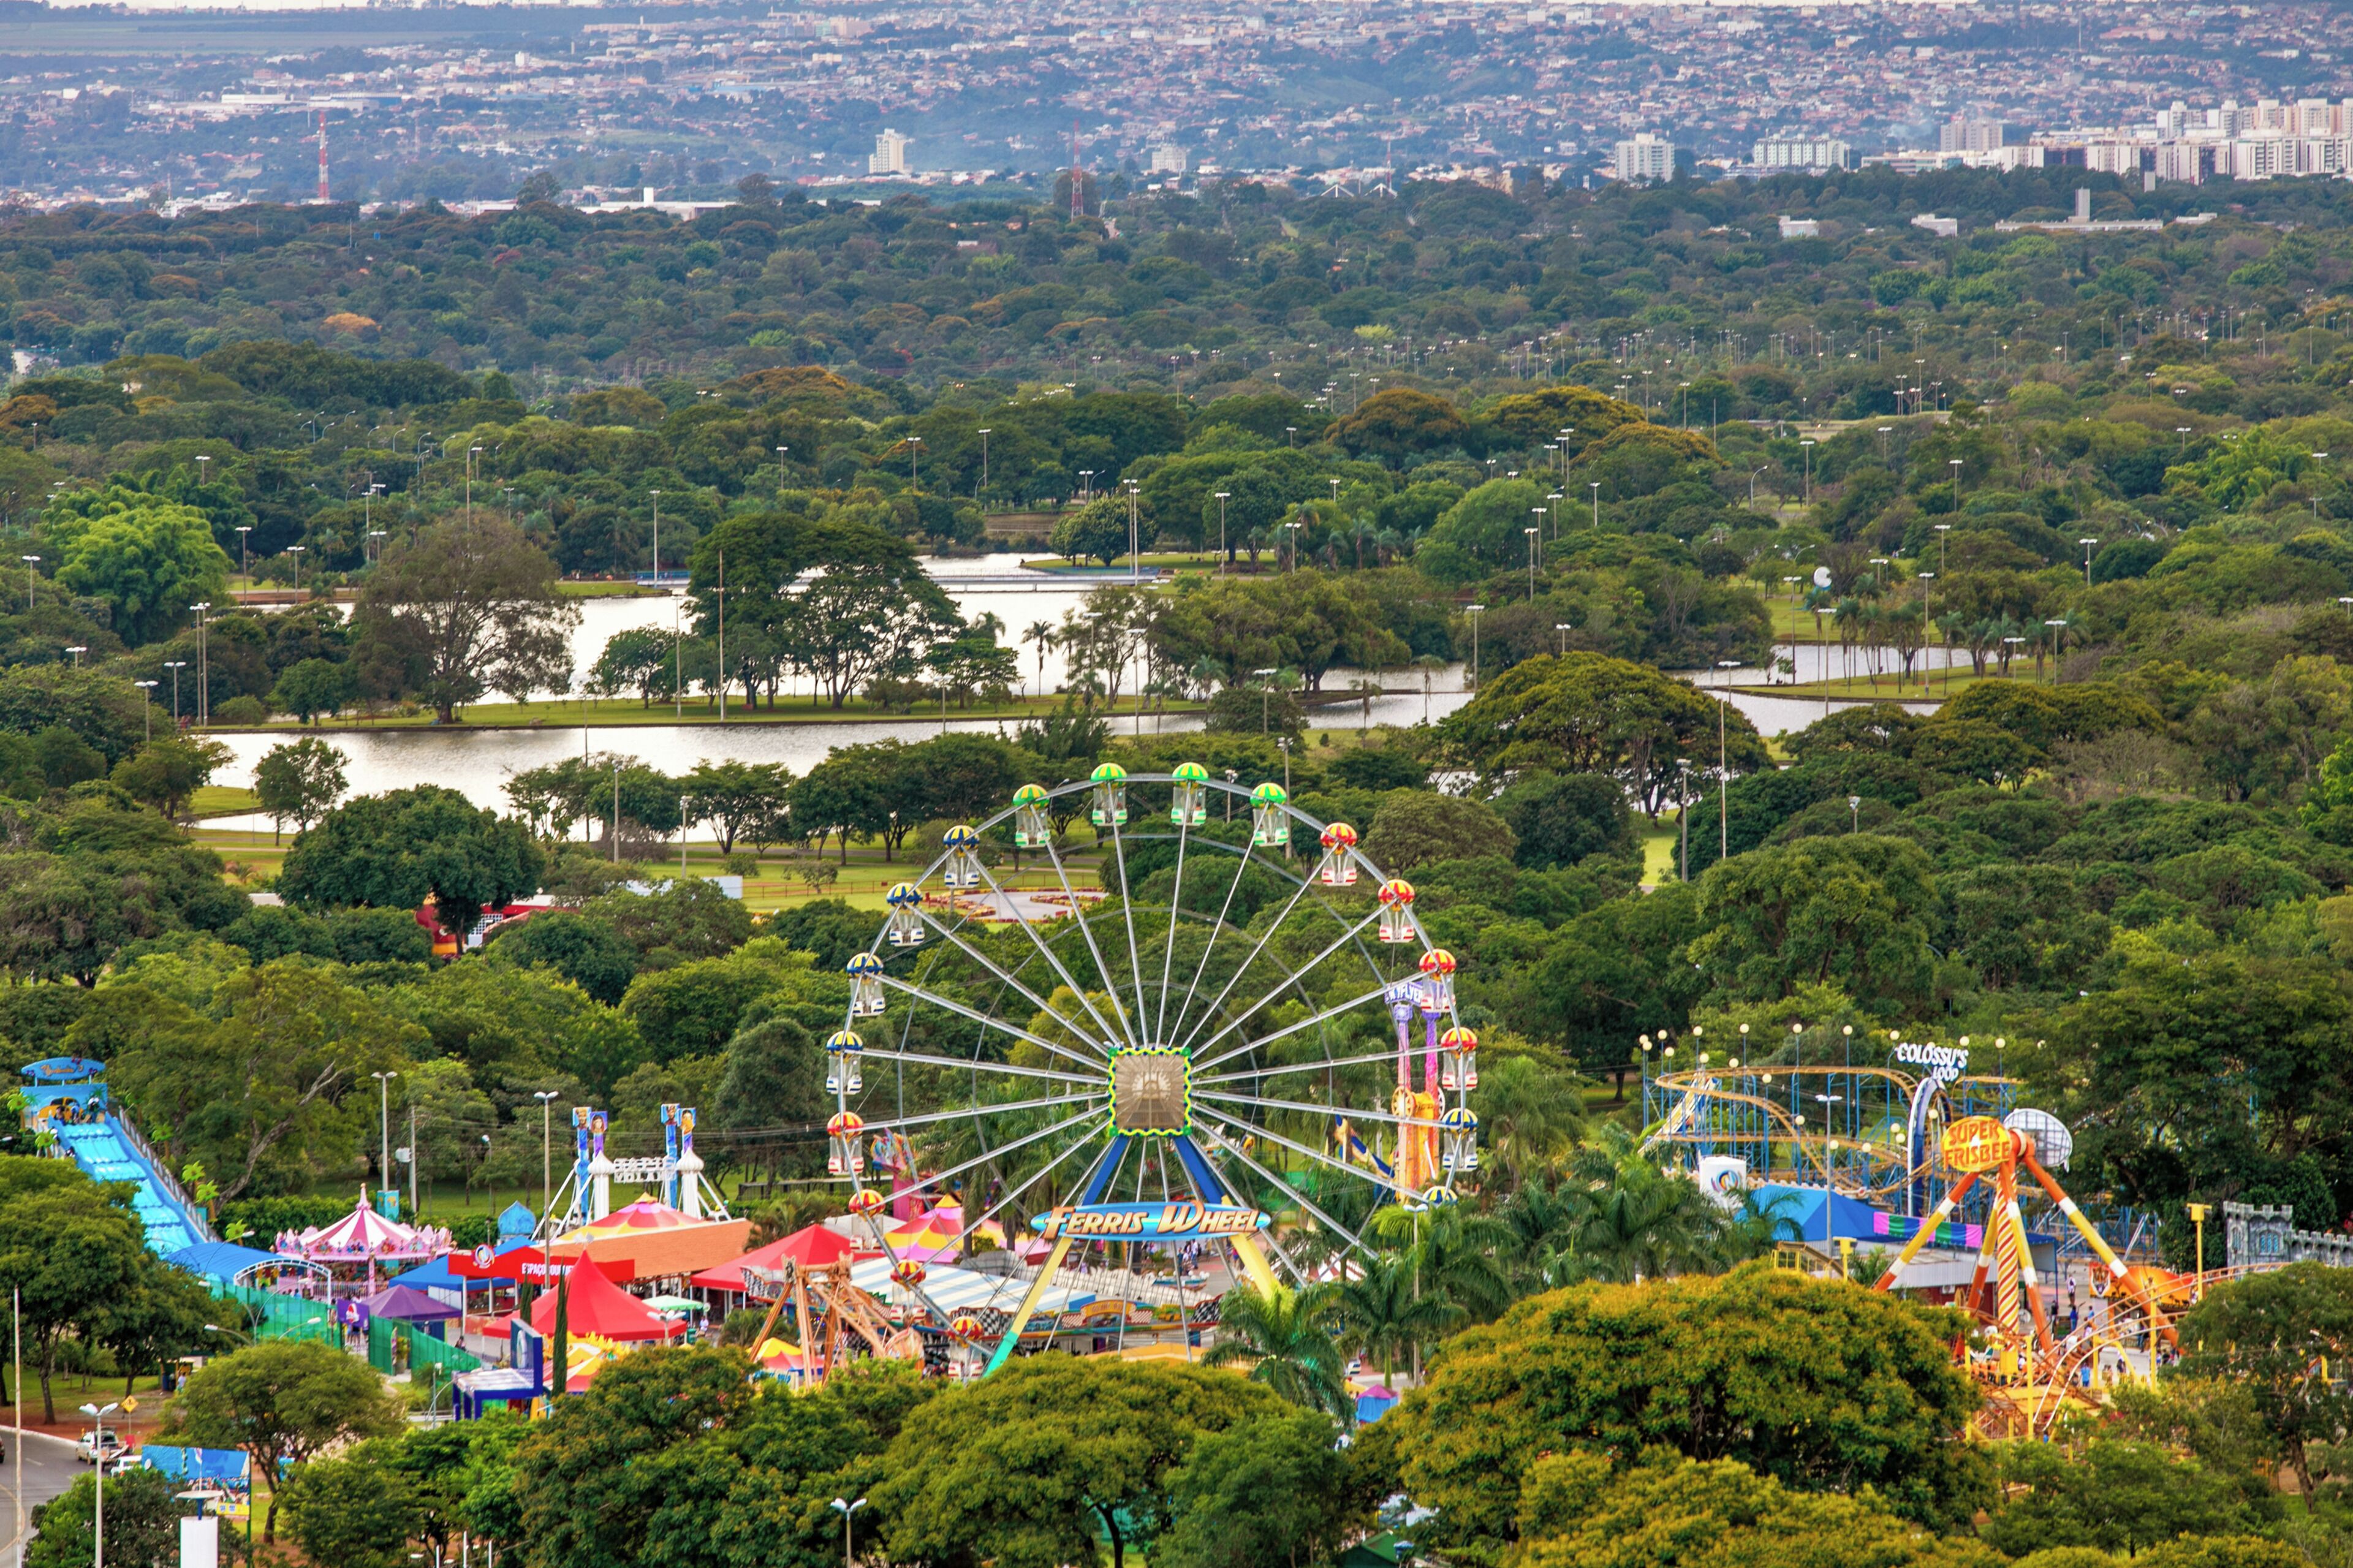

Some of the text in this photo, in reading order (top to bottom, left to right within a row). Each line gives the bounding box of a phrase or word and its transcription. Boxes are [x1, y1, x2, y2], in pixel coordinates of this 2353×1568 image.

[1895, 1042, 1969, 1068] COLOSSU'S
[1932, 1066, 1959, 1081] LOOP
[1949, 1119, 1999, 1145] SUPER
[1945, 1142, 2010, 1167] FRISBEE
[1043, 1200, 1259, 1240] FERRIS WHEEL
